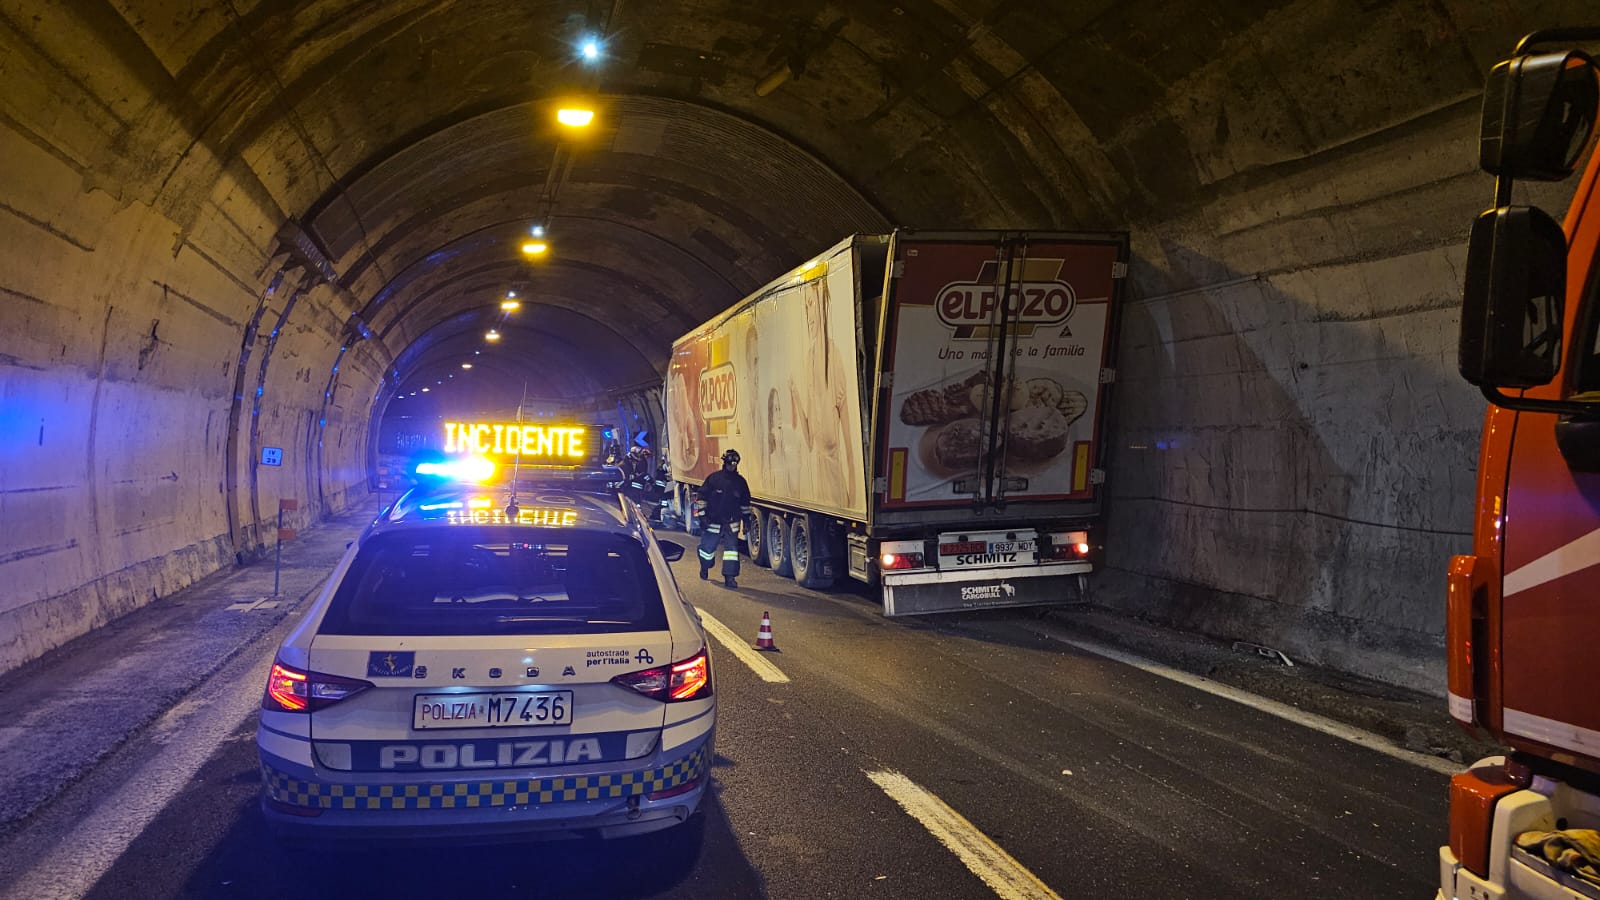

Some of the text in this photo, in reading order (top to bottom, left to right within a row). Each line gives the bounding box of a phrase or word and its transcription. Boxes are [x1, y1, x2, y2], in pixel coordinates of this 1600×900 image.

[938, 346, 964, 359] Uno
[1028, 346, 1038, 356] la
[1043, 344, 1085, 358] familia
[444, 422, 585, 457] INCIDENTE
[995, 542, 1014, 552] 9937
[956, 552, 1017, 566] SCHMITZ
[961, 585, 1001, 595] SCHMITZ
[962, 592, 1001, 600] CARGOBULL
[586, 650, 630, 658] autostrade
[586, 659, 602, 667] per
[422, 696, 565, 723] POLIZIA M7436
[379, 737, 603, 769] POLIZIA
